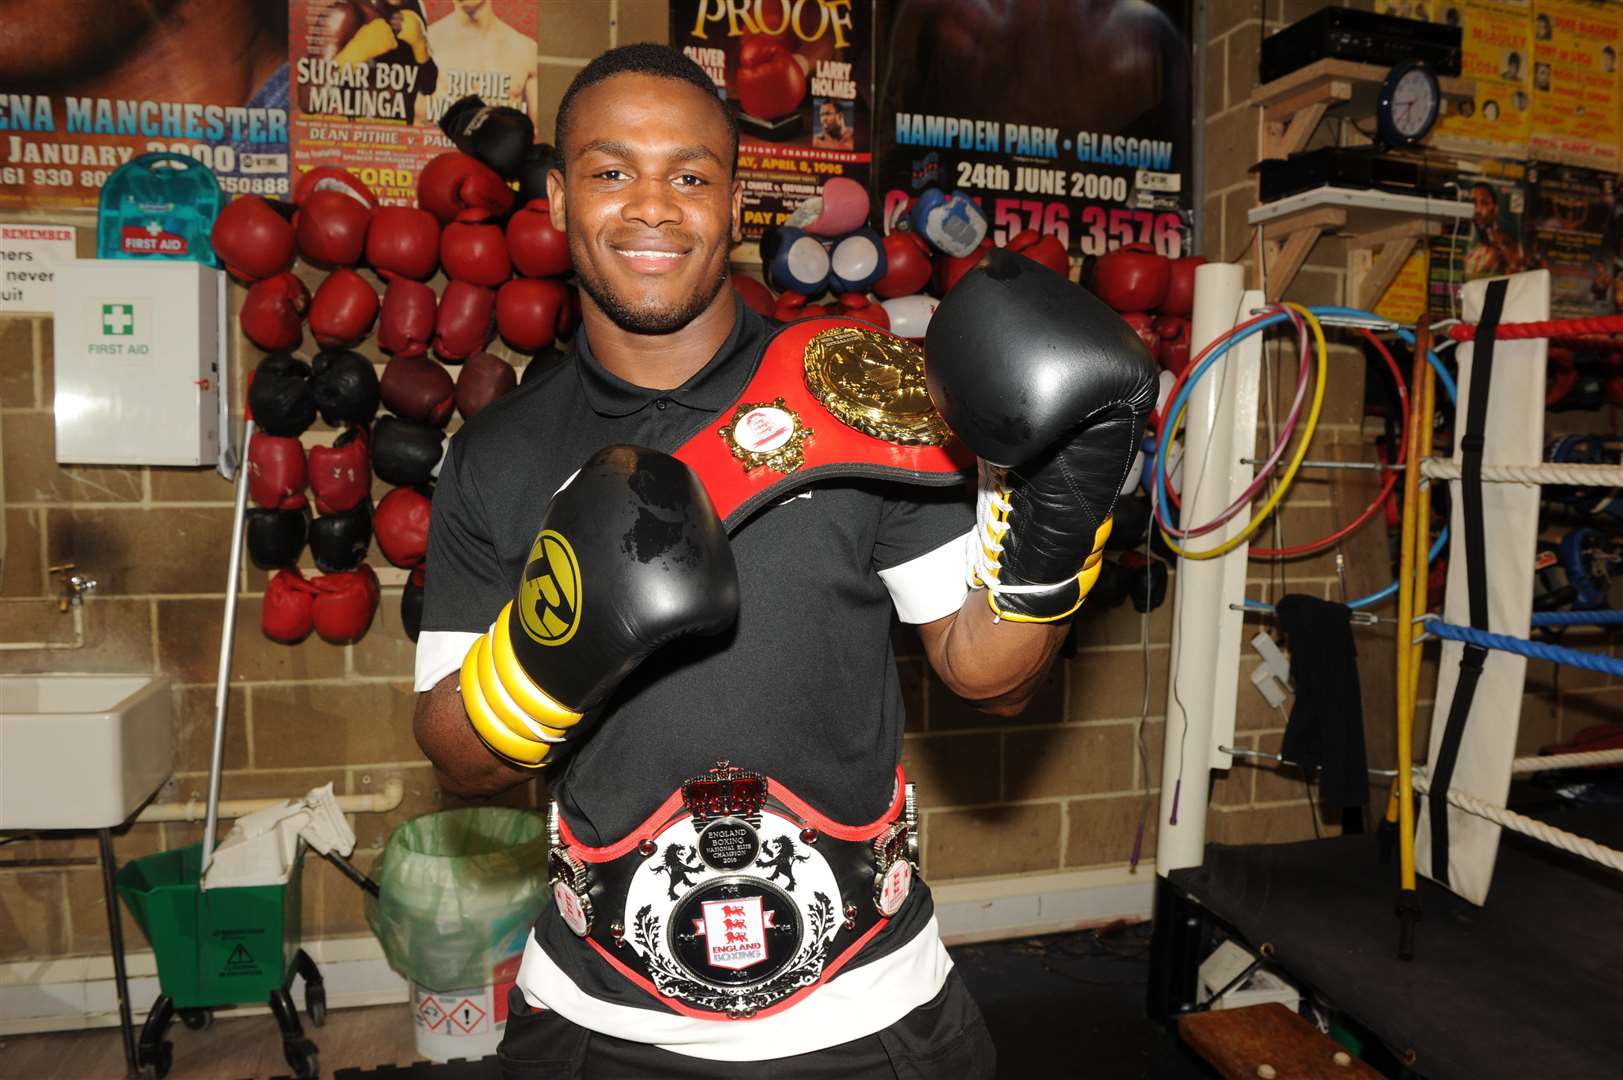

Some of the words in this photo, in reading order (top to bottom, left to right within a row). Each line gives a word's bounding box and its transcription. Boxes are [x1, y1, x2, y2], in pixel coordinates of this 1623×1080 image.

[691, 0, 853, 48] PROOF
[297, 57, 369, 88] SUGAR
[375, 62, 419, 93] BOY
[815, 60, 852, 80] LARRY
[447, 72, 511, 100] RICHIE
[811, 78, 856, 99] HOLMES
[308, 84, 406, 119] MALINGA
[65, 97, 288, 143] MANCHESTER
[309, 127, 349, 141] DEAN
[353, 130, 399, 144] PITHIE
[896, 113, 1000, 151] HAMPDEN
[1005, 124, 1059, 157] PARK
[1077, 132, 1173, 170] GLASGOW
[761, 159, 797, 170] APRIL
[0, 167, 25, 185] 61
[33, 168, 74, 187] 930
[957, 162, 1010, 191] 24th
[1014, 167, 1067, 196] JUNE
[1071, 172, 1127, 202] 2000
[744, 211, 773, 225] PAY
[994, 198, 1070, 250] 576
[1081, 206, 1181, 260] 3576
[125, 238, 157, 249] FIRST
[160, 239, 181, 250] AID
[6, 271, 54, 282] never
[88, 344, 123, 354] FIRST
[127, 344, 149, 354] AID
[708, 829, 747, 839] ENGLAND
[712, 837, 744, 847] BOXING
[706, 845, 735, 853] NATIONAL
[713, 850, 746, 858] CHAMPION
[712, 942, 761, 953] ENGLAND
[713, 951, 761, 961] BOXING
